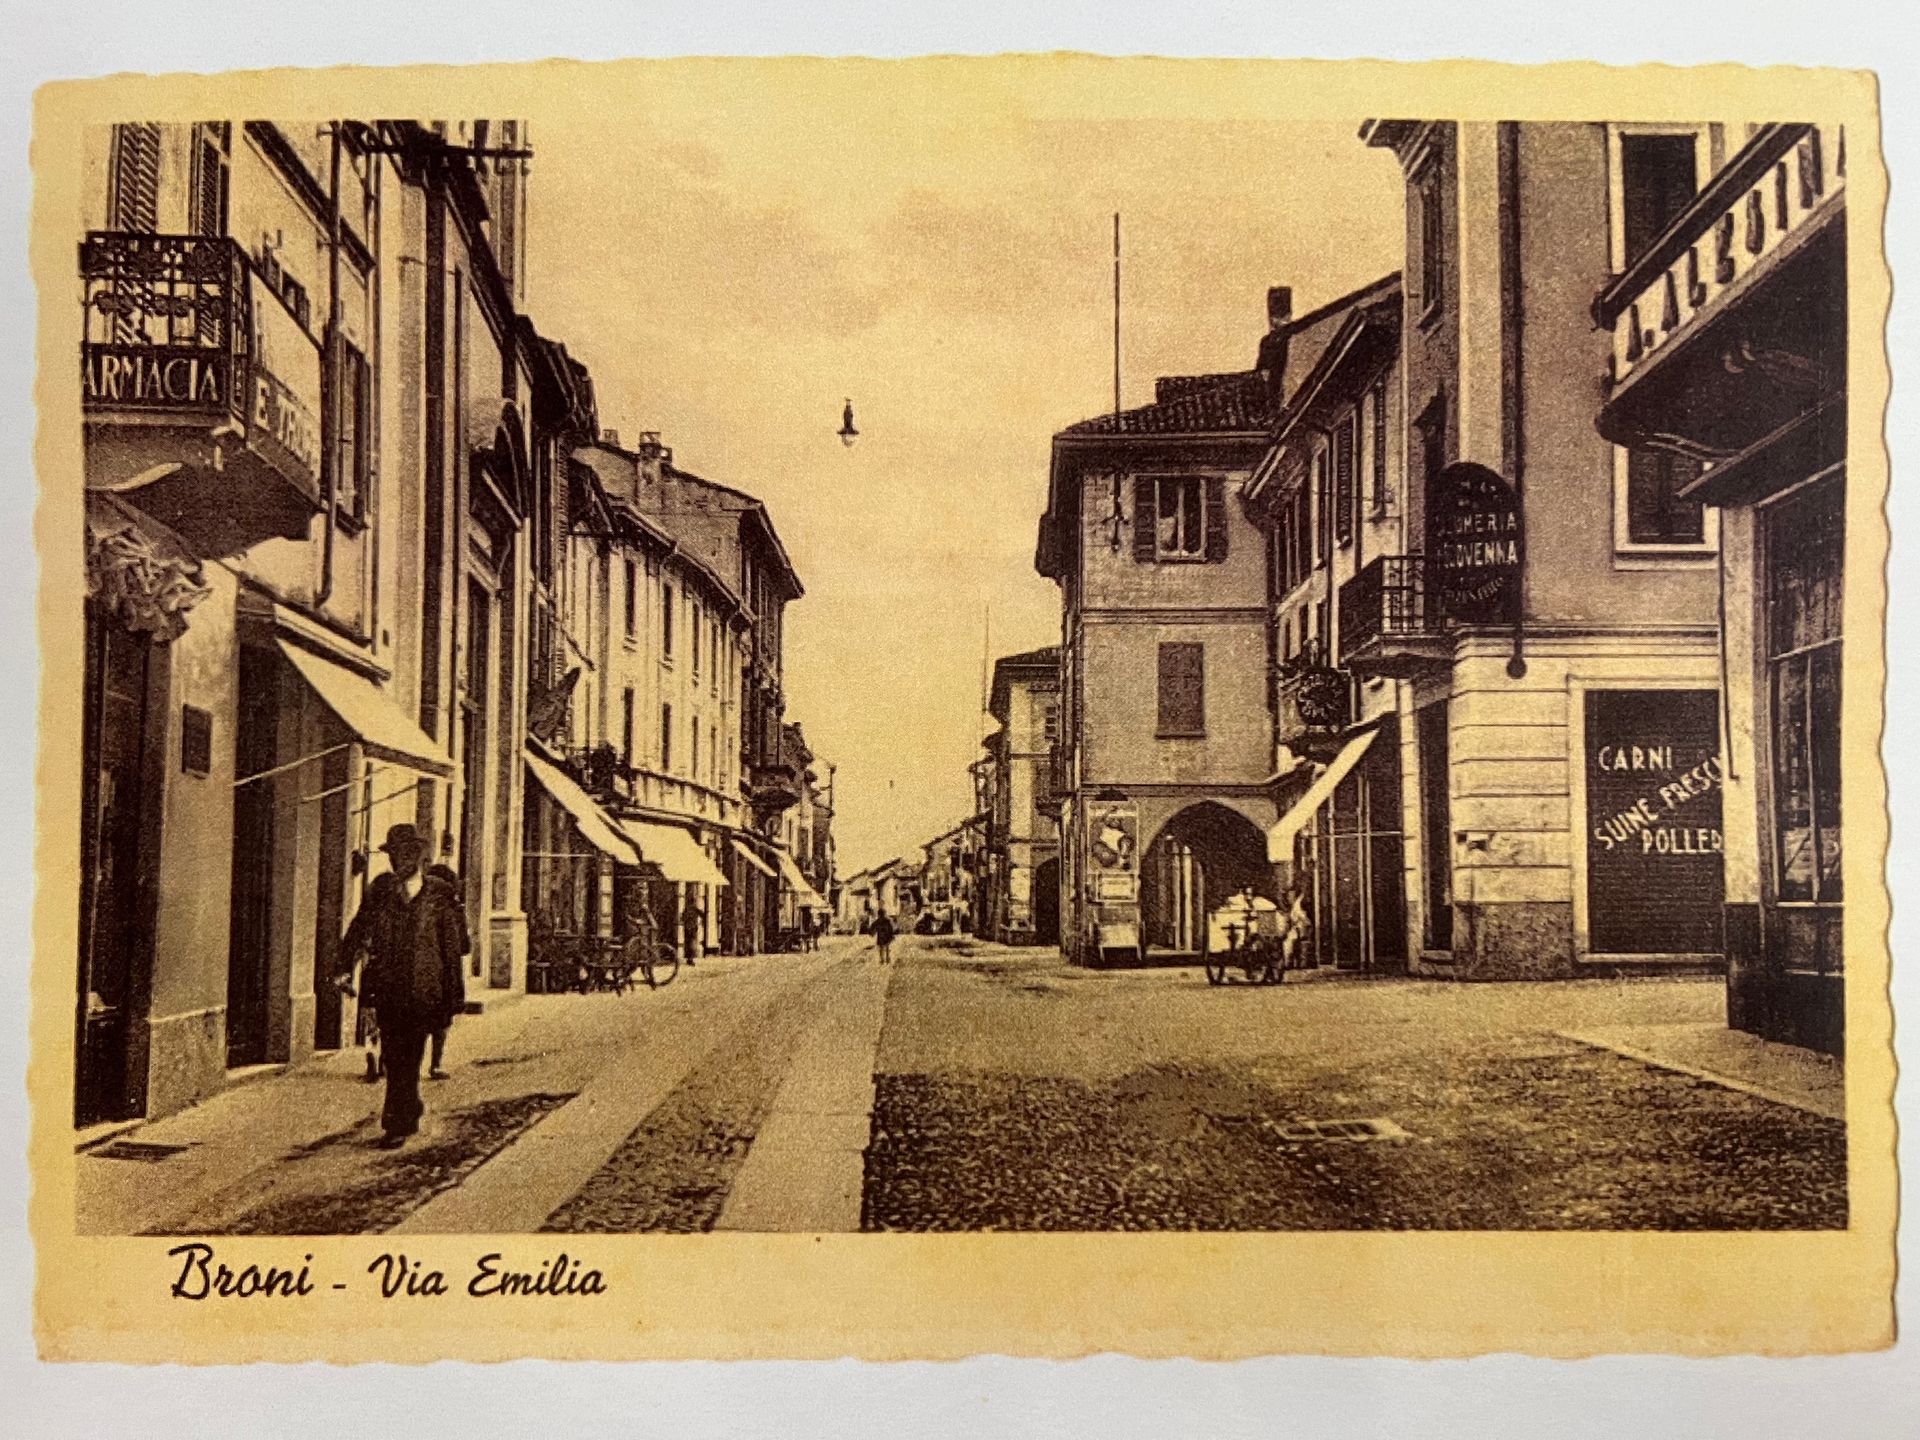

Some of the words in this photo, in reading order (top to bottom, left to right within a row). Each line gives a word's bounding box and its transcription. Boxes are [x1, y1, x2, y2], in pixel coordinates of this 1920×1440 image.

[1598, 745, 1672, 771] CARNI
[1594, 797, 1659, 851] SUINE
[168, 1243, 315, 1300] Broni
[367, 1253, 449, 1298] Via
[467, 1252, 607, 1297] Emilia
